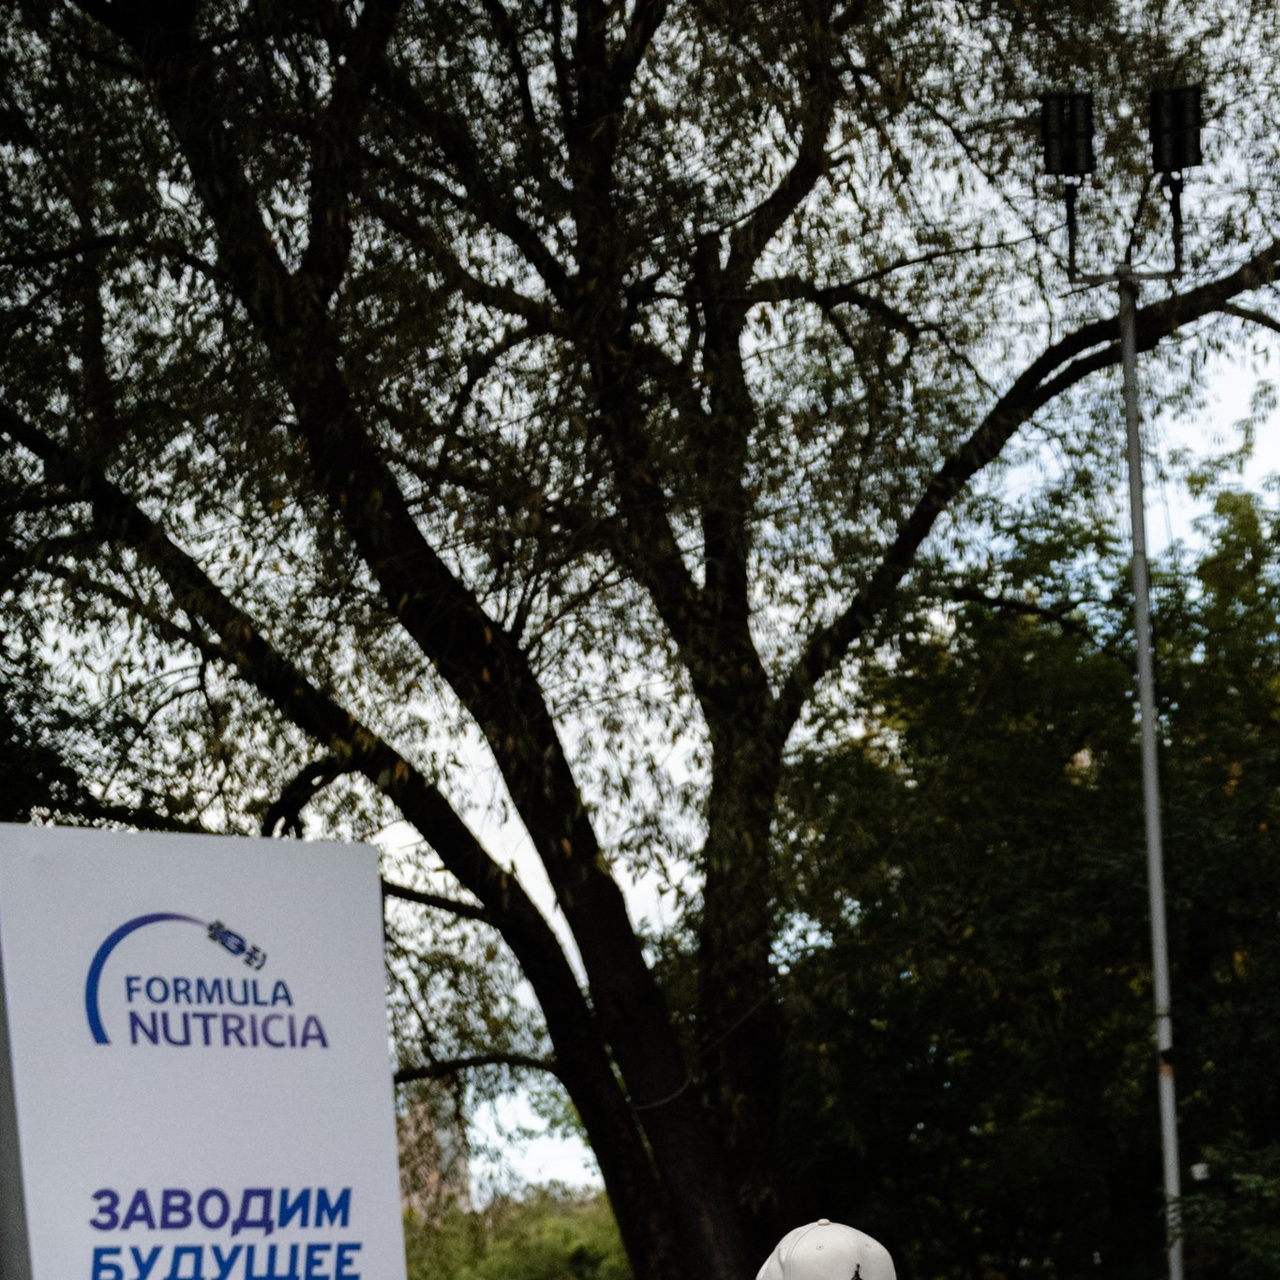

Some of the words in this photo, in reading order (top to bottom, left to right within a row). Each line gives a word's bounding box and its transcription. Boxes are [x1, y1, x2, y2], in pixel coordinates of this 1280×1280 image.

[125, 975, 293, 1007] FORMULA
[129, 1010, 329, 1048] NUTRICIA
[89, 1187, 352, 1237] ЗАВОДИМ
